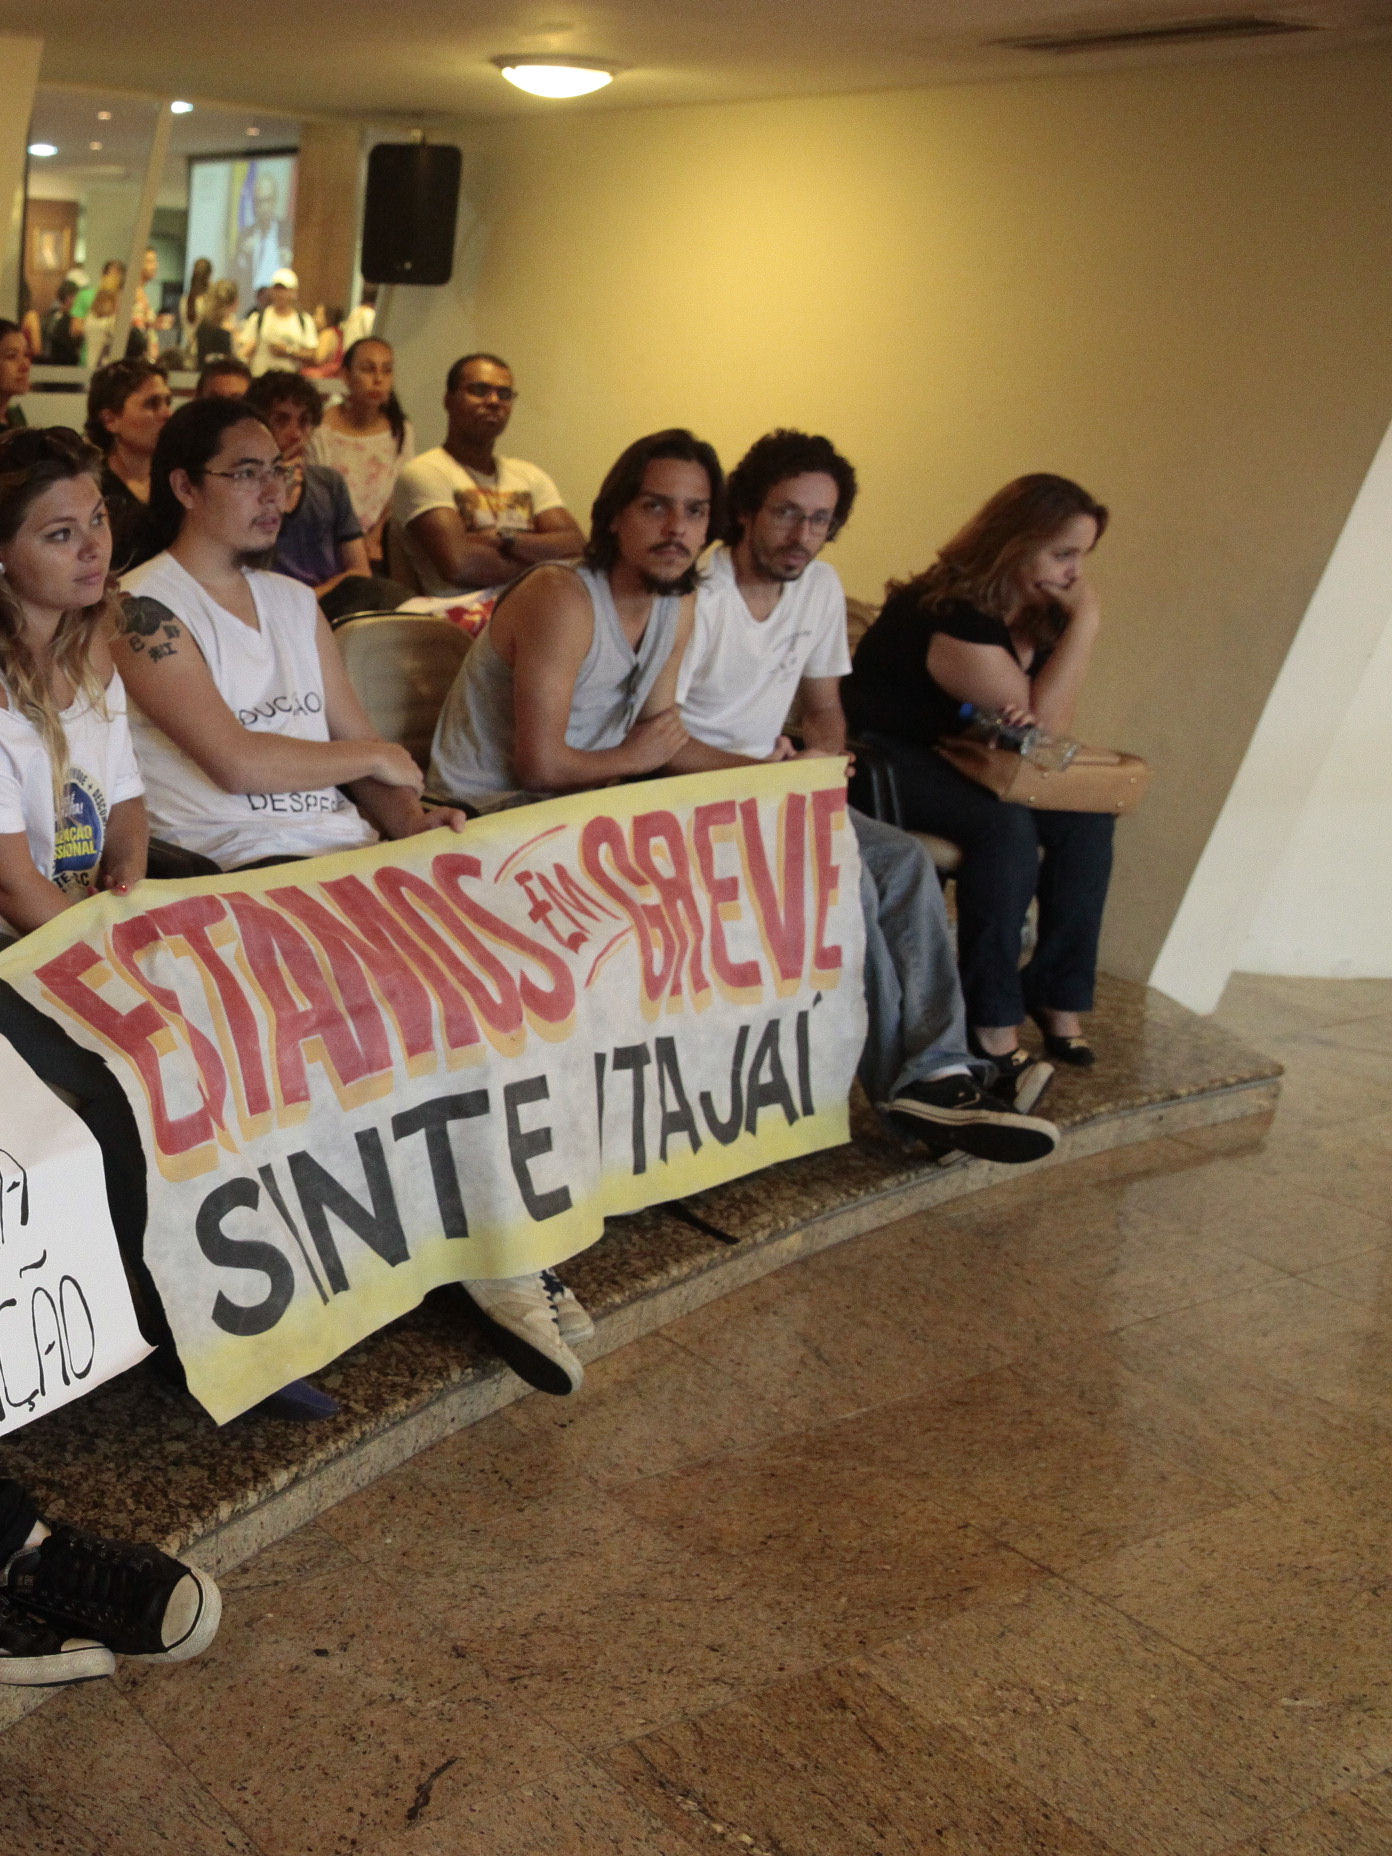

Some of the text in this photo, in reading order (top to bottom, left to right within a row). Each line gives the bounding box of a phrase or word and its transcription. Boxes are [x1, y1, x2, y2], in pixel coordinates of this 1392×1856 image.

[34, 787, 848, 1158] ESTAMOS EM GREVE
[195, 992, 821, 1339] SINTE ITAJAÍ
